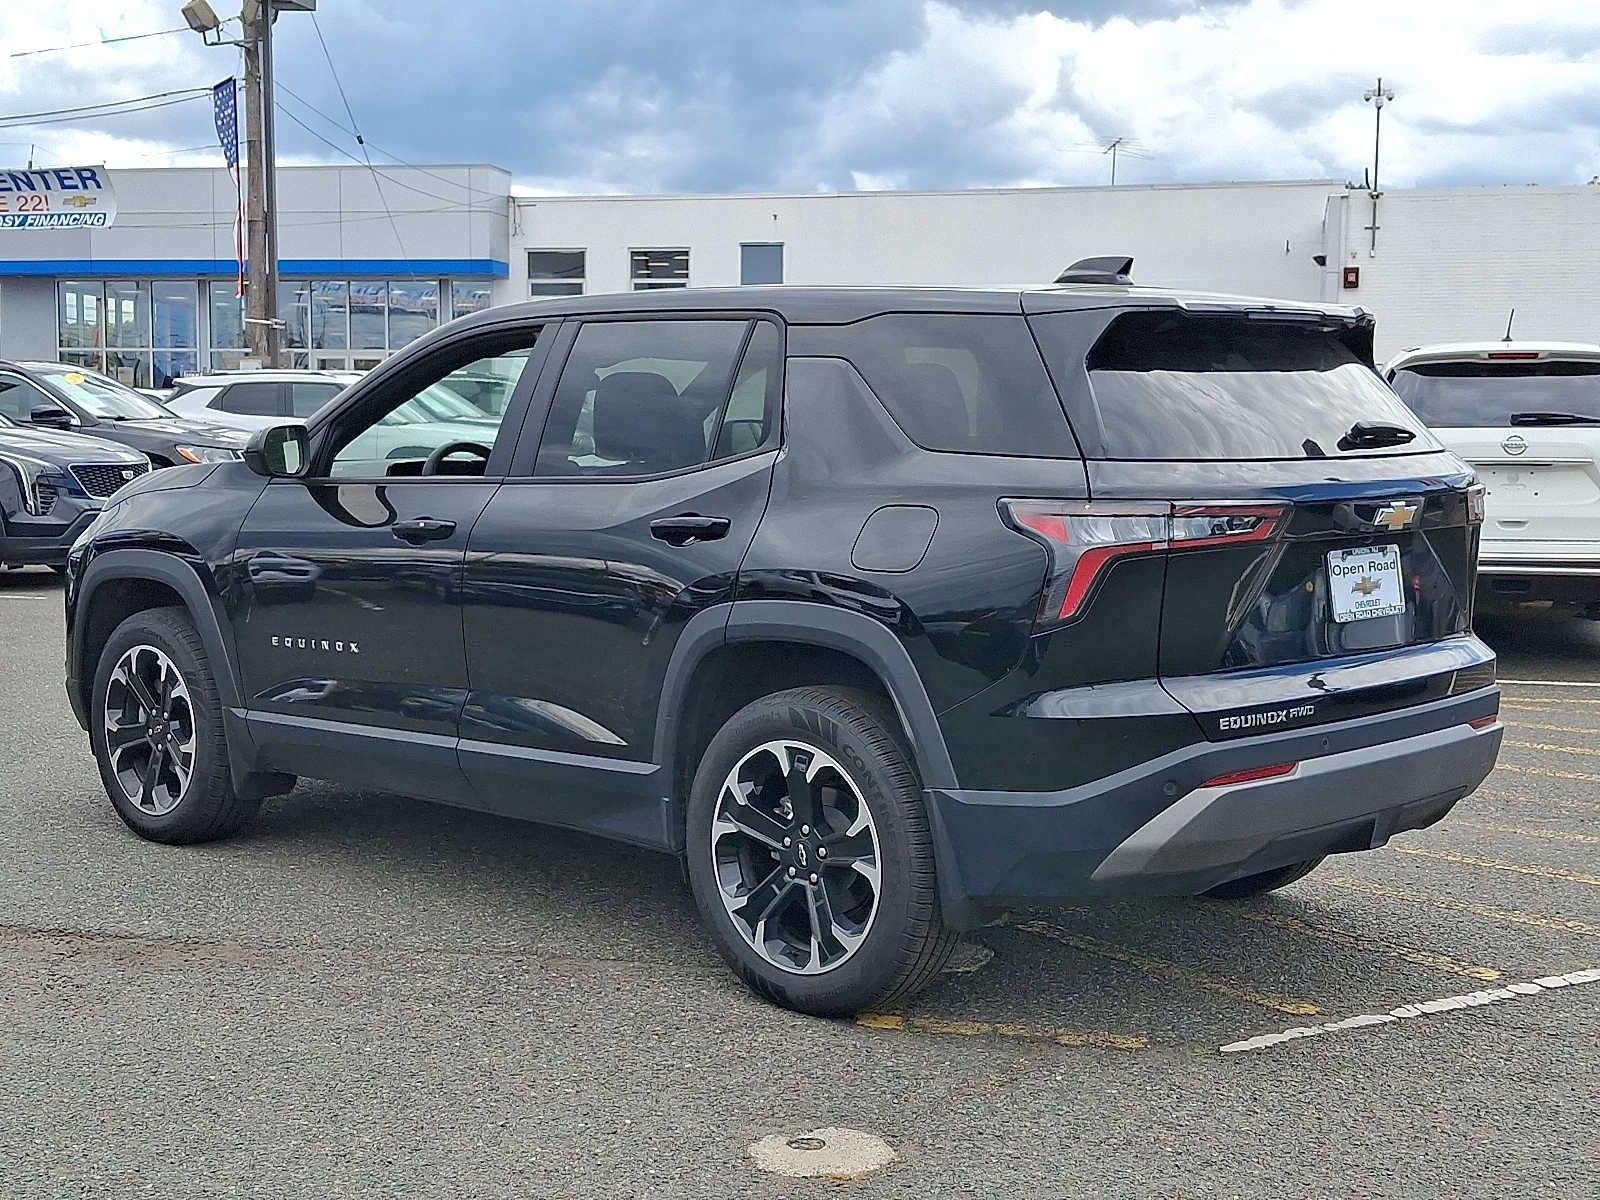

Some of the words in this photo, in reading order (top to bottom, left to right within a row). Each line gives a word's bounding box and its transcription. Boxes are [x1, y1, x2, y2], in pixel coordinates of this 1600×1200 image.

[16, 194, 50, 212] 22!
[25, 213, 104, 226] FINANCING
[1333, 564, 1364, 578] Open
[1368, 559, 1395, 572] Road
[1355, 609, 1371, 619] ROAD
[271, 636, 359, 653] EQUINOX
[1219, 709, 1288, 730] EQUINOX
[1289, 705, 1315, 719] AWD
